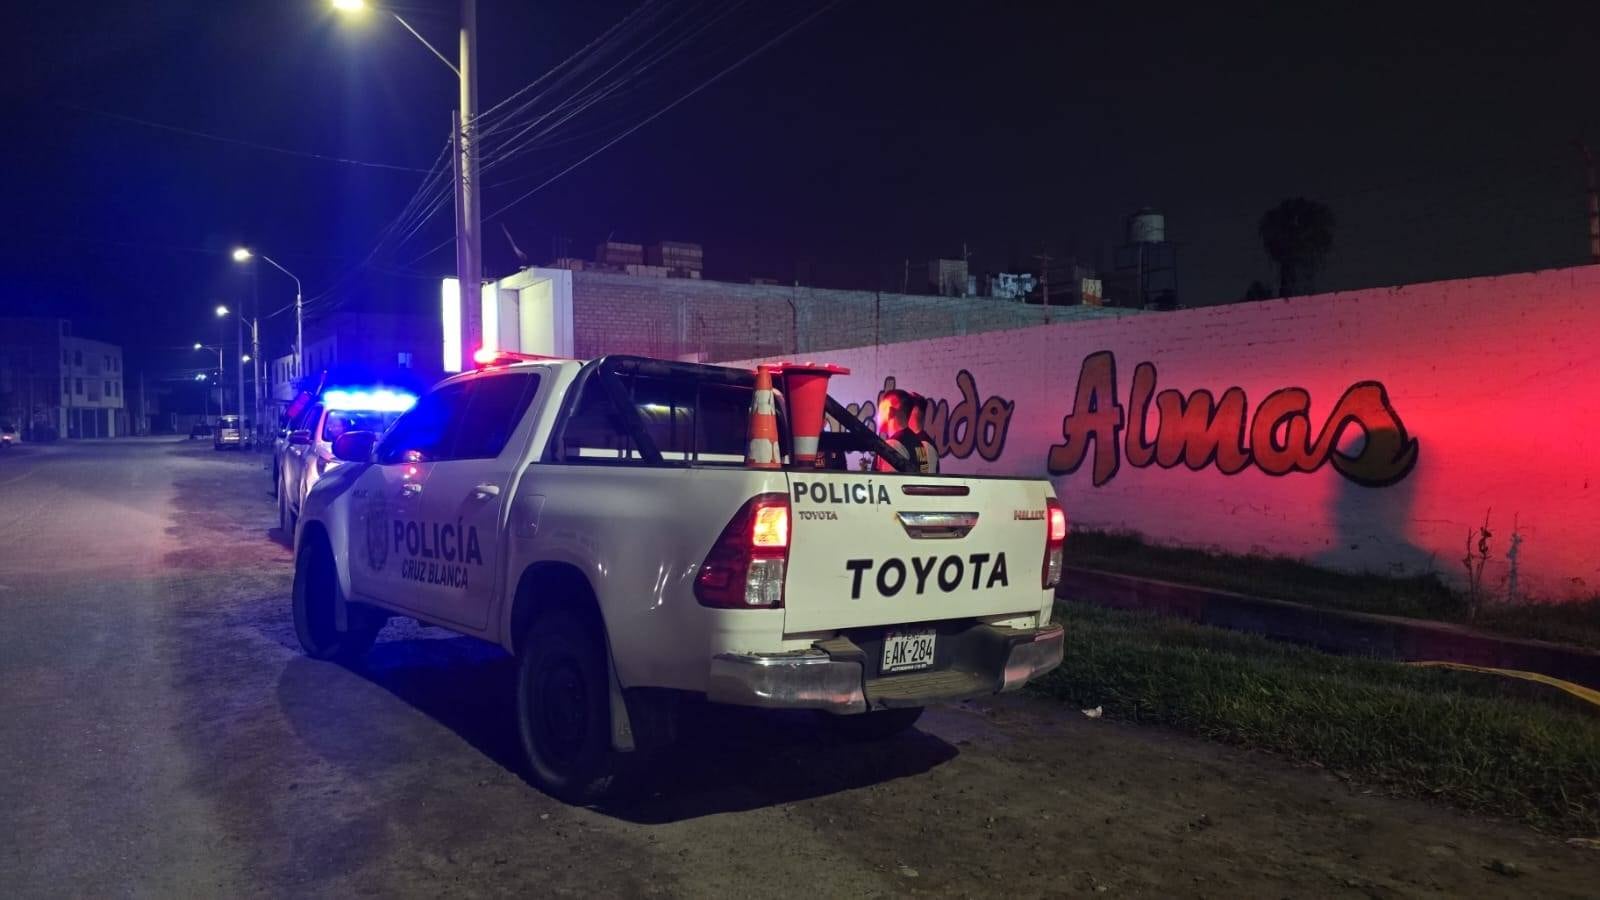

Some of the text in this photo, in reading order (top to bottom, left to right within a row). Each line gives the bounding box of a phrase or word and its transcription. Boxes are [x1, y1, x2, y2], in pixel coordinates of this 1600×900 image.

[1047, 350, 1419, 487] Almas
[793, 479, 891, 504] POLICÍA
[799, 511, 838, 520] TOYOTA
[394, 516, 482, 566] POLICÍA
[402, 559, 468, 589] CRUZ BLANCA
[846, 551, 1008, 600] TOYOTA
